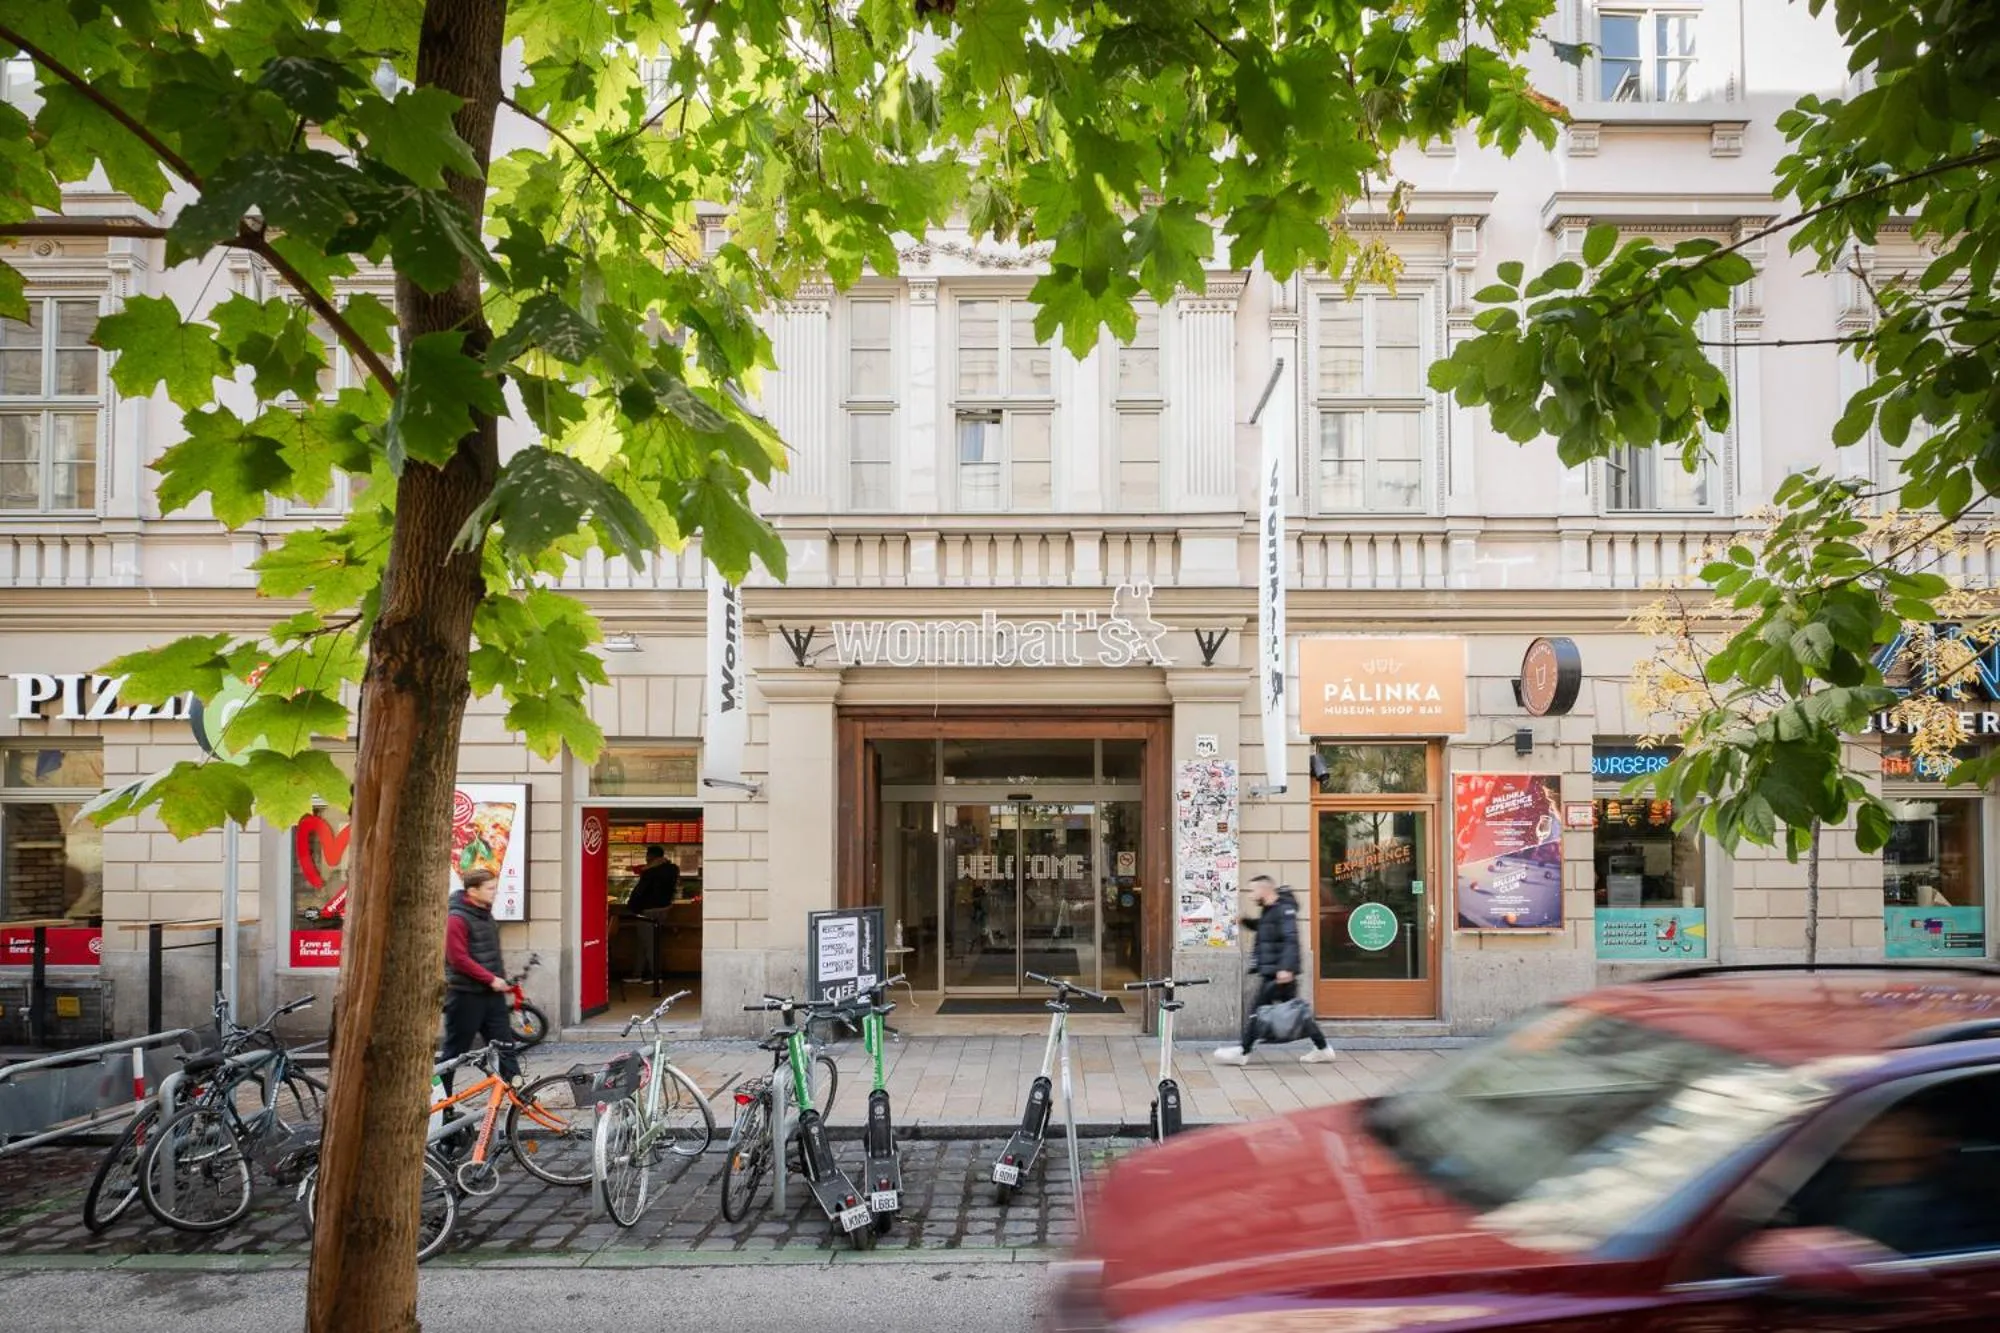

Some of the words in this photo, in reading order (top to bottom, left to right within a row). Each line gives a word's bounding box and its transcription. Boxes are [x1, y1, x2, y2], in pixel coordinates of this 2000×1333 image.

[832, 609, 1137, 666] wombat's
[1324, 678, 1441, 701] PÁLINKA
[1324, 705, 1374, 715] MUSEUM
[1381, 704, 1413, 715] SHOP
[1418, 704, 1442, 715] BAR
[1335, 845, 1410, 874] EXPERIENCE
